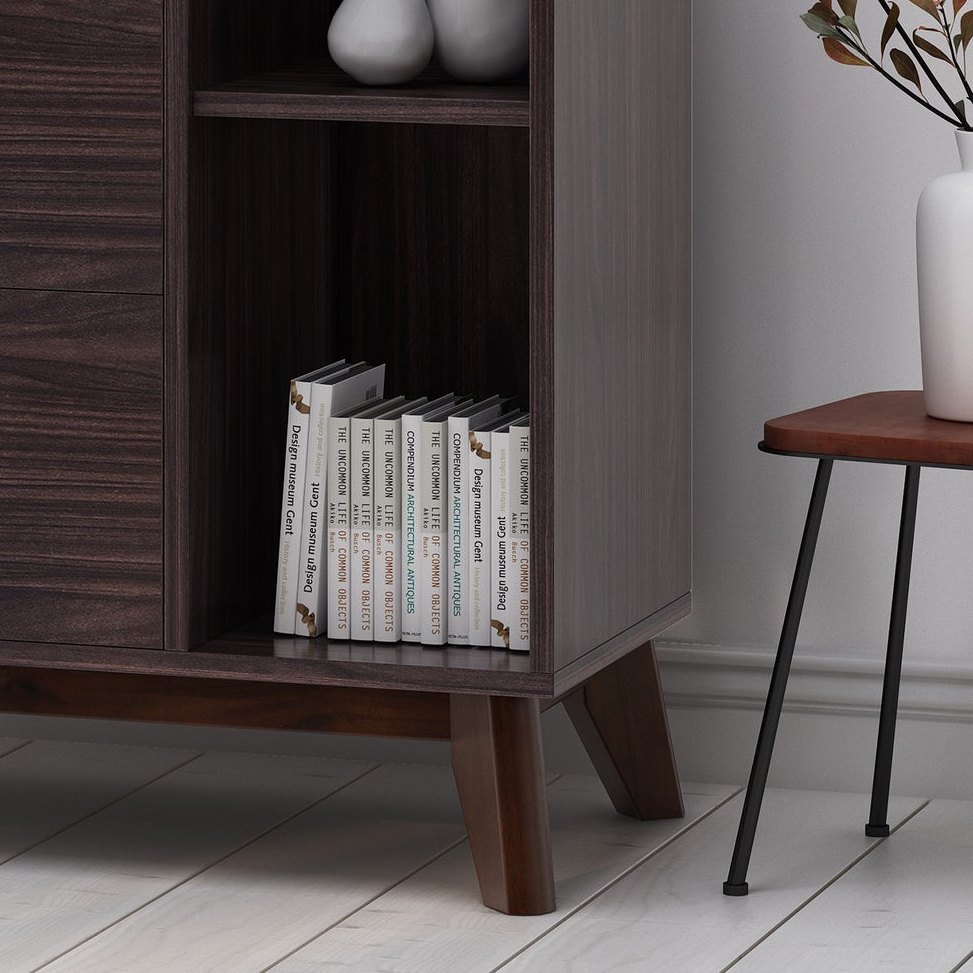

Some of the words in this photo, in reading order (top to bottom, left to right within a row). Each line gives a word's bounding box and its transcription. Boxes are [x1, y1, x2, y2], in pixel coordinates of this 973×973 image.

[288, 425, 302, 460] Design
[338, 427, 346, 443] THE
[362, 427, 370, 444] THE
[385, 429, 393, 445] THE
[432, 431, 440, 447] THE
[520, 436, 529, 452] THE
[315, 452, 324, 477] History
[338, 449, 346, 495] UNCOMMON
[362, 450, 370, 497] UNCOMMON
[385, 451, 393, 497] UNCOMMON
[407, 431, 415, 492] COMPENDIUM
[432, 454, 440, 500] UNCOMMON
[453, 433, 461, 494] COMPENDIUM
[286, 463, 297, 506] museum
[310, 482, 320, 508] Gent
[472, 468, 483, 499] Design
[520, 459, 529, 505] UNCOMMON
[285, 510, 296, 535] Gent
[338, 502, 346, 524] LIFE
[362, 503, 370, 525] LIFE
[385, 505, 393, 527] LIFE
[432, 507, 440, 529] LIFE
[497, 517, 507, 538] Gent
[520, 512, 529, 534] LIFE
[308, 512, 318, 555] museum
[338, 531, 346, 542] OF
[362, 532, 370, 543] OF
[385, 533, 393, 545] OF
[407, 494, 415, 567] ARCHITECTURAL
[432, 536, 440, 547] OF
[453, 496, 461, 569] ARCHITECTURAL
[520, 541, 529, 553] OF
[281, 541, 290, 565] History
[338, 548, 346, 582] COMMON
[362, 549, 370, 583] COMMON
[385, 551, 393, 585] COMMON
[474, 541, 483, 563] Gent
[498, 541, 506, 577] museum
[304, 558, 316, 593] Design
[432, 553, 440, 587] COMMON
[520, 559, 529, 593] COMMON
[279, 581, 287, 615] collection
[406, 569, 415, 614] ANTIQUES
[453, 571, 461, 617] ANTIQUES
[497, 581, 508, 610] Design
[338, 589, 346, 629] OBJECTS
[362, 590, 370, 630] OBJECTS
[385, 591, 393, 631] OBJECTS
[432, 594, 440, 635] OBJECTS
[520, 599, 529, 640] OBJECTS
